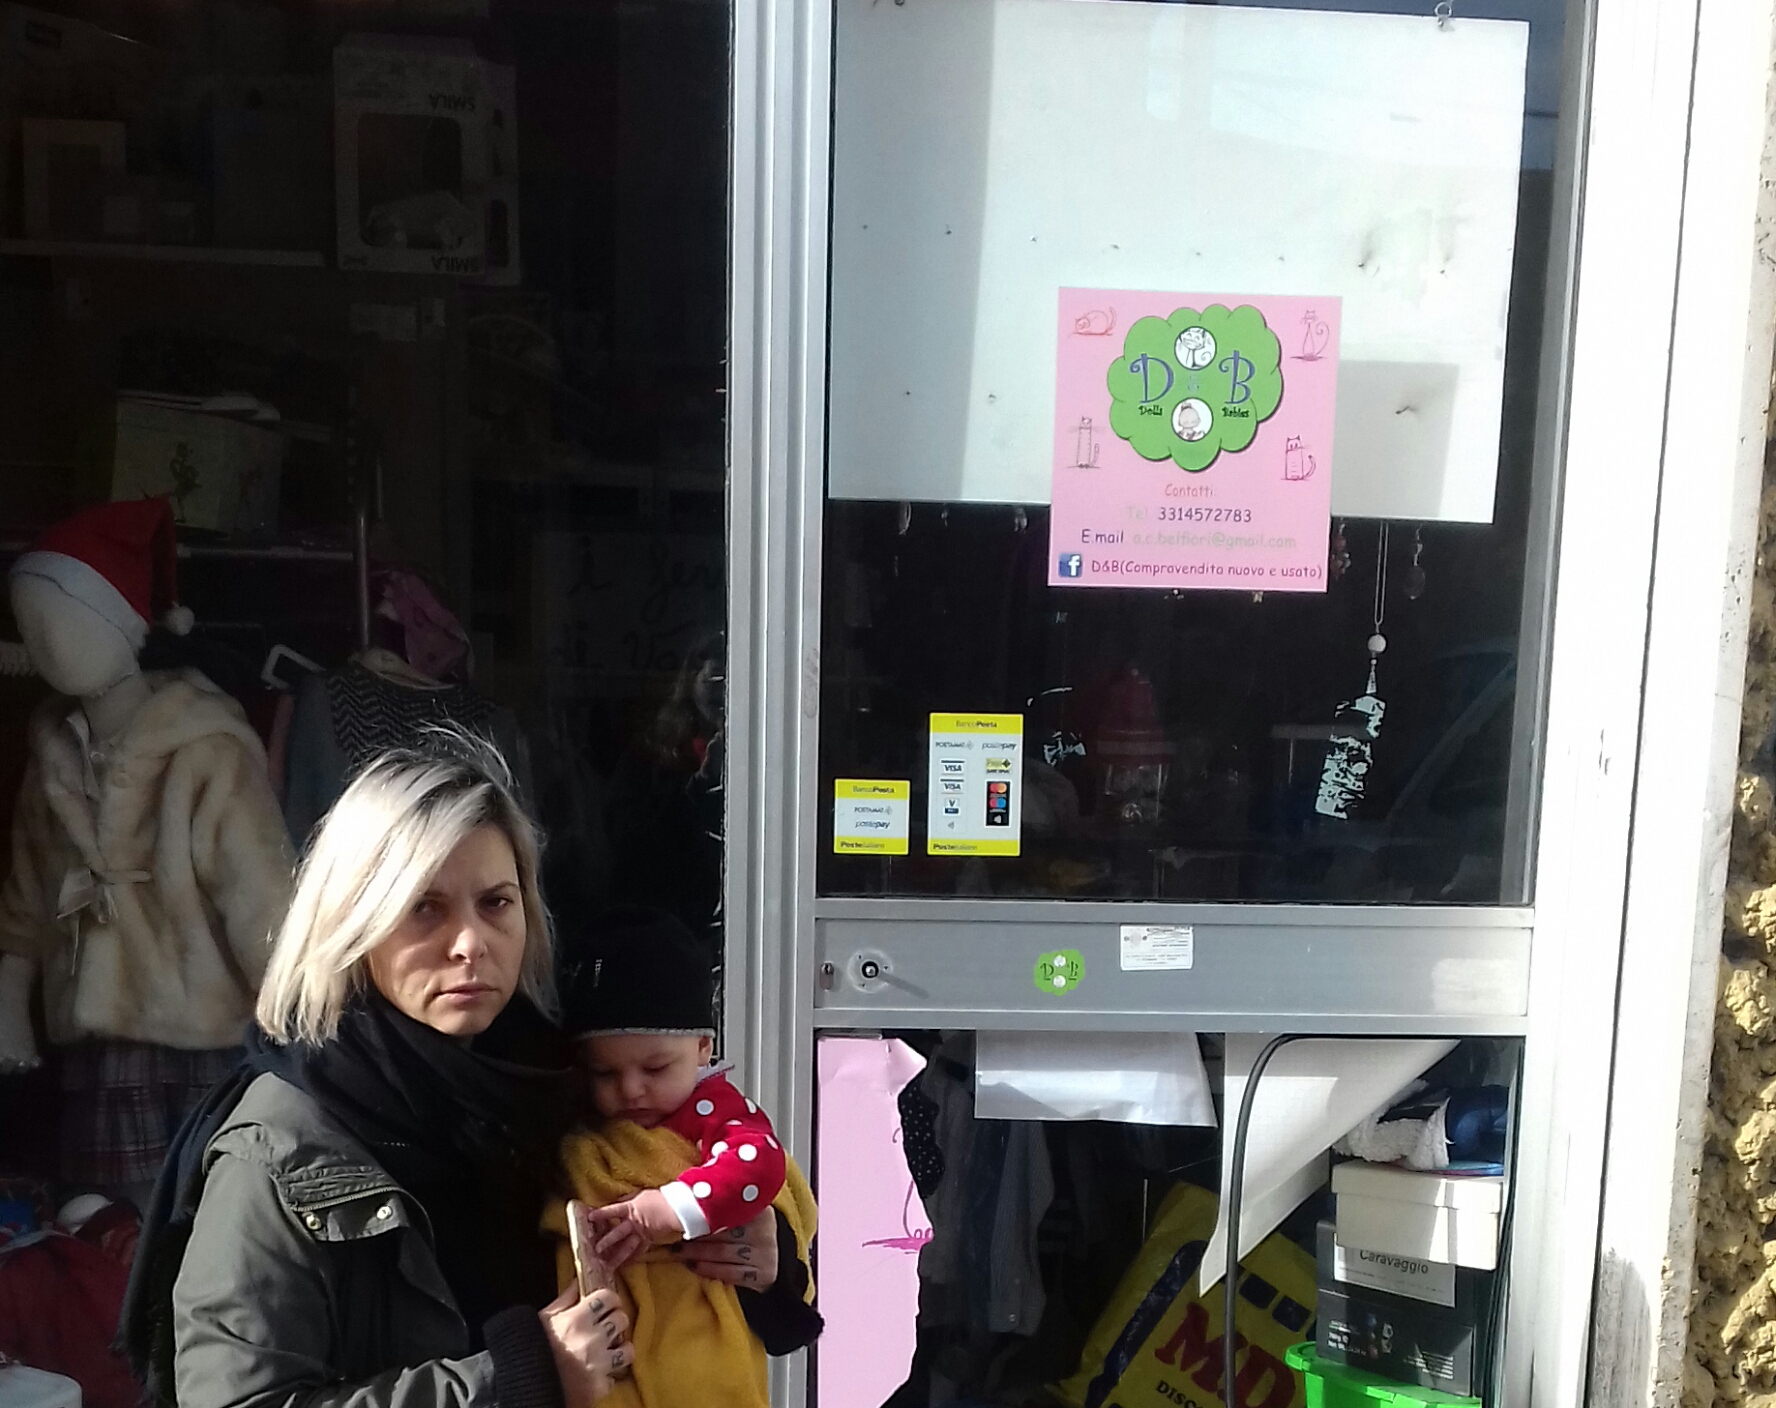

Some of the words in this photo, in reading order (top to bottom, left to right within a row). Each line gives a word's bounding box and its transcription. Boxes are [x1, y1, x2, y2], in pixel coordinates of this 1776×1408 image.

[1129, 352, 1175, 404] D
[1218, 349, 1256, 405] B
[1158, 506, 1252, 523] 3314572783
[1091, 559, 1225, 578] D&B(Compravendita
[1227, 565, 1265, 578] nuovo
[1269, 566, 1277, 578] e
[1281, 564, 1323, 580] usato)
[944, 764, 963, 772] VISA
[944, 782, 962, 790] VISA
[1359, 1250, 1429, 1275] Caravaggio
